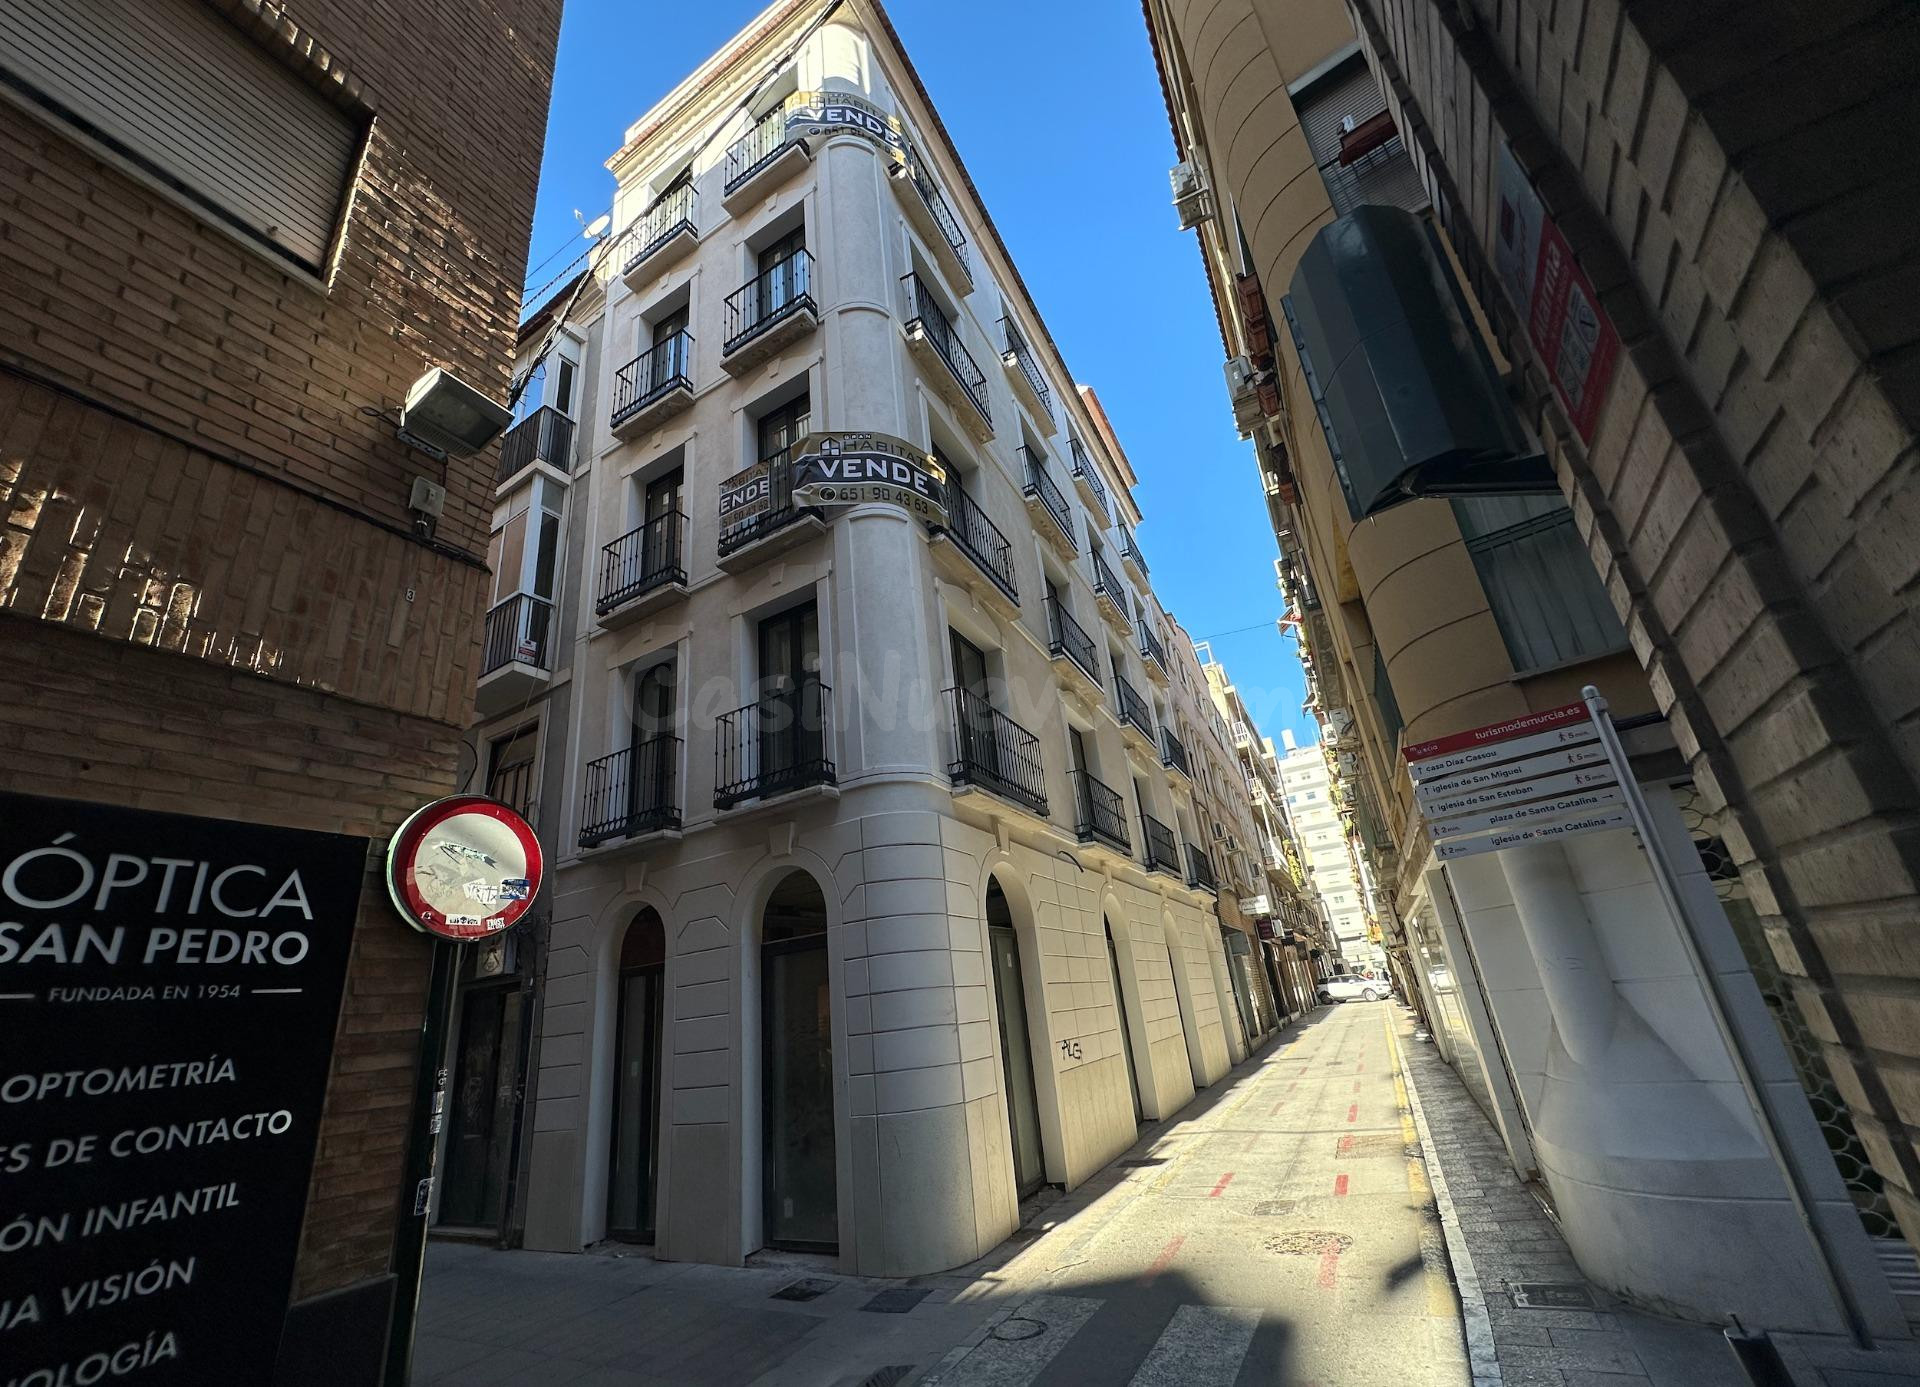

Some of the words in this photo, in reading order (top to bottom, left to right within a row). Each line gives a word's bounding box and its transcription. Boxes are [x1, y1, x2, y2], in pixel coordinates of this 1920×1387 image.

[806, 109, 899, 147] VENDE
[843, 440, 925, 469] HABITAT
[817, 458, 929, 495] VENDE
[840, 487, 865, 501] 651
[872, 487, 890, 500] 90
[914, 501, 928, 514] 63
[1475, 706, 1581, 740] turismodemurcia.es
[1426, 763, 1445, 772] casa
[1465, 751, 1497, 763] Cassou
[1432, 782, 1459, 793] iglesia
[1461, 778, 1472, 786] de
[1473, 775, 1490, 783] San
[1490, 766, 1522, 780] Miguel
[1437, 801, 1465, 812] iglesia
[1466, 797, 1477, 805] de
[1479, 793, 1496, 802] San
[1497, 785, 1534, 798] Esteban
[1489, 814, 1513, 824] plaza
[1528, 805, 1555, 815] Santa
[1557, 796, 1598, 810] Catalina
[1491, 834, 1520, 846] iglesia
[1522, 831, 1534, 839] de
[1535, 827, 1563, 837] Santa
[1565, 818, 1606, 831] Catalina
[2, 832, 314, 921] ÓPTICA
[0, 920, 126, 965] SAN
[142, 927, 310, 966] PEDRO
[48, 986, 155, 1003] FUNDADA
[161, 985, 190, 1001] EN
[196, 984, 241, 1000] 1954
[0, 1053, 236, 1104] OPTOMETRÍA
[44, 1135, 98, 1168] DE
[109, 1109, 293, 1158] CONTACTO
[0, 1212, 71, 1253] ÓN
[81, 1182, 240, 1237] INFANTIL
[60, 1256, 196, 1315] VISIÓN
[6, 1330, 177, 1387] OLOGÍA
